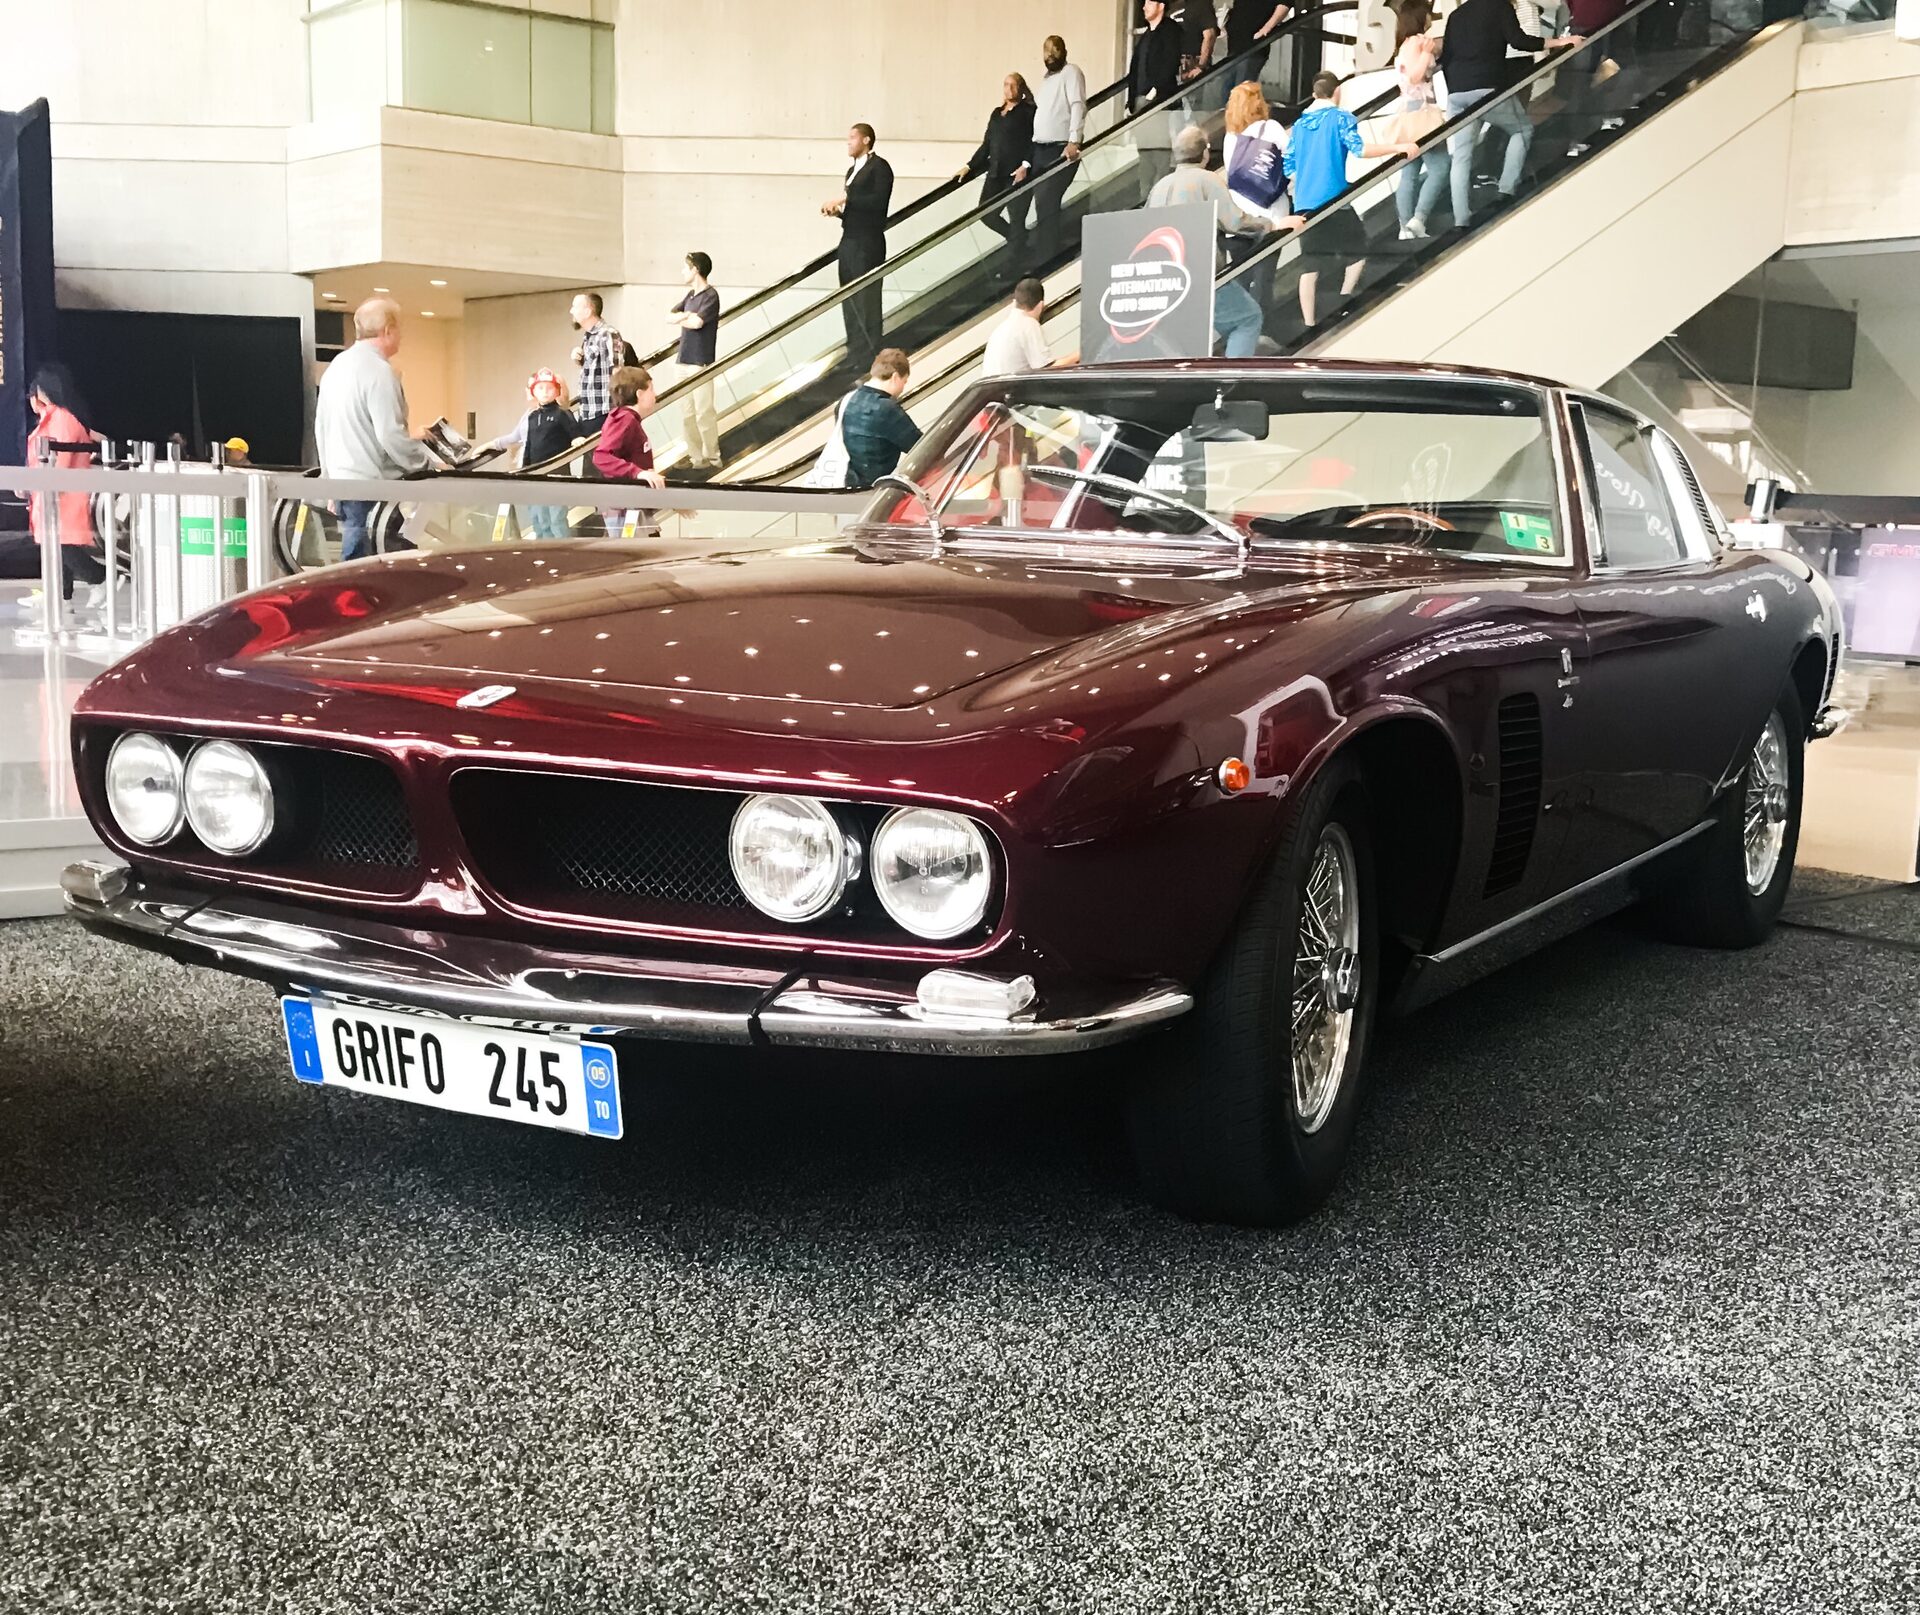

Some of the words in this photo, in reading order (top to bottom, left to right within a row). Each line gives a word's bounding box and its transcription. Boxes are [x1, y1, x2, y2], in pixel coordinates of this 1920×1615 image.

[1111, 263, 1135, 278] NEW
[1135, 261, 1163, 276] YORK
[1110, 277, 1184, 295] INTERNATIONAL
[1110, 298, 1138, 313] AUTO
[1137, 296, 1169, 312] SHOW
[1512, 515, 1520, 528] 1
[1540, 536, 1550, 549] 3
[332, 1017, 446, 1095] GRIFO
[483, 1042, 568, 1116] 245
[591, 1067, 606, 1082] 05
